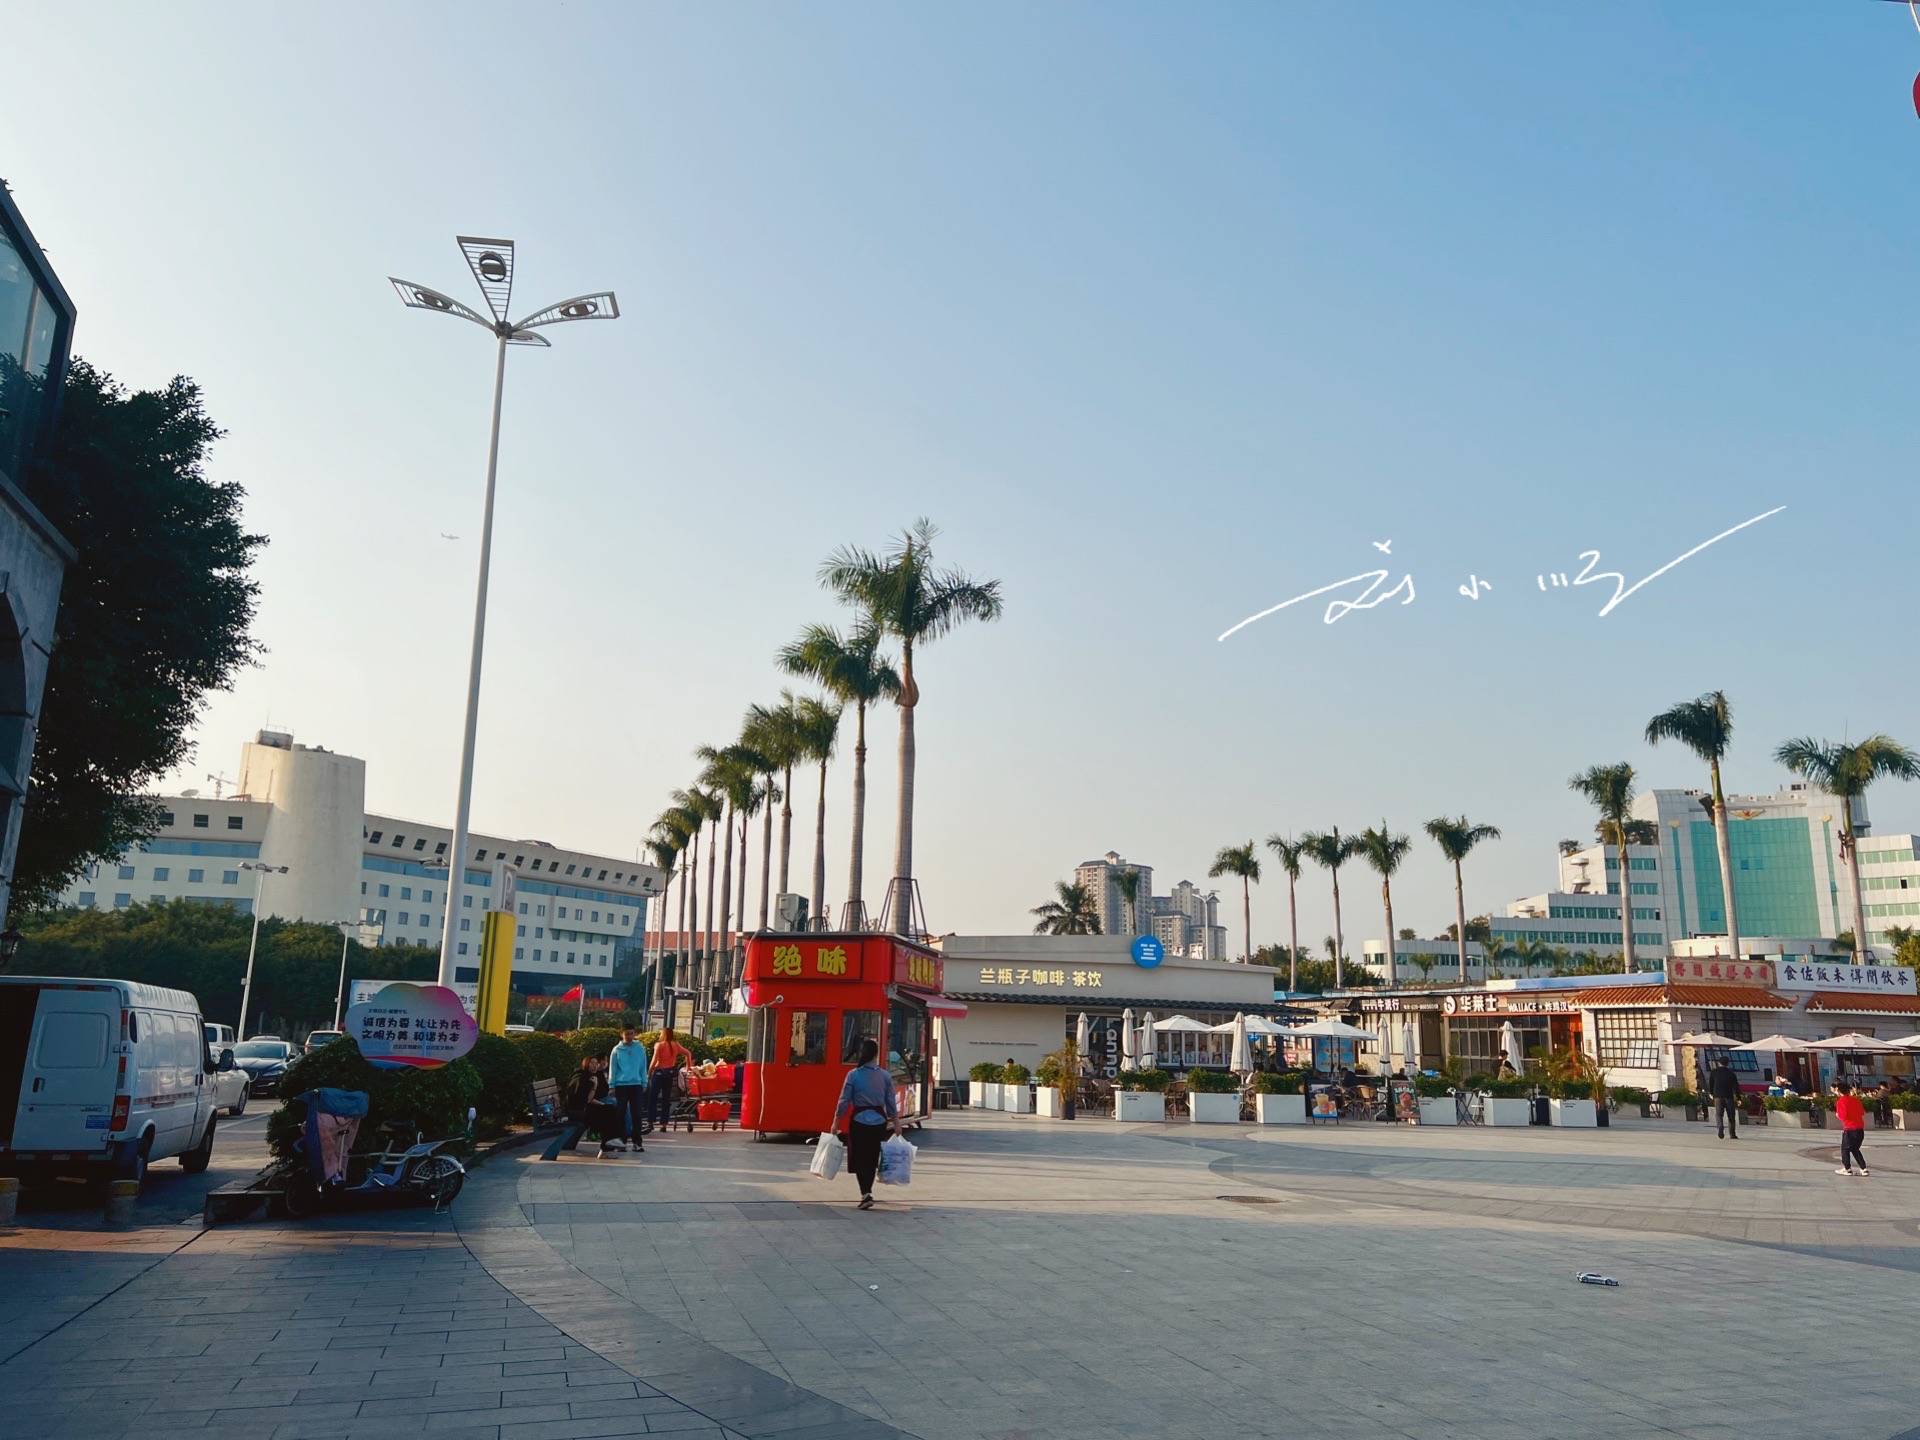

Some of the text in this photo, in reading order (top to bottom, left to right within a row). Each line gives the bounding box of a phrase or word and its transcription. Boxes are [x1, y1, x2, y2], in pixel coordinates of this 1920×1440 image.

[772, 944, 848, 976] 绝味
[979, 967, 1102, 987] 兰瓶子咖啡·茶饮
[1460, 994, 1498, 1012] 华莱士
[1507, 1002, 1538, 1013] WALLACE
